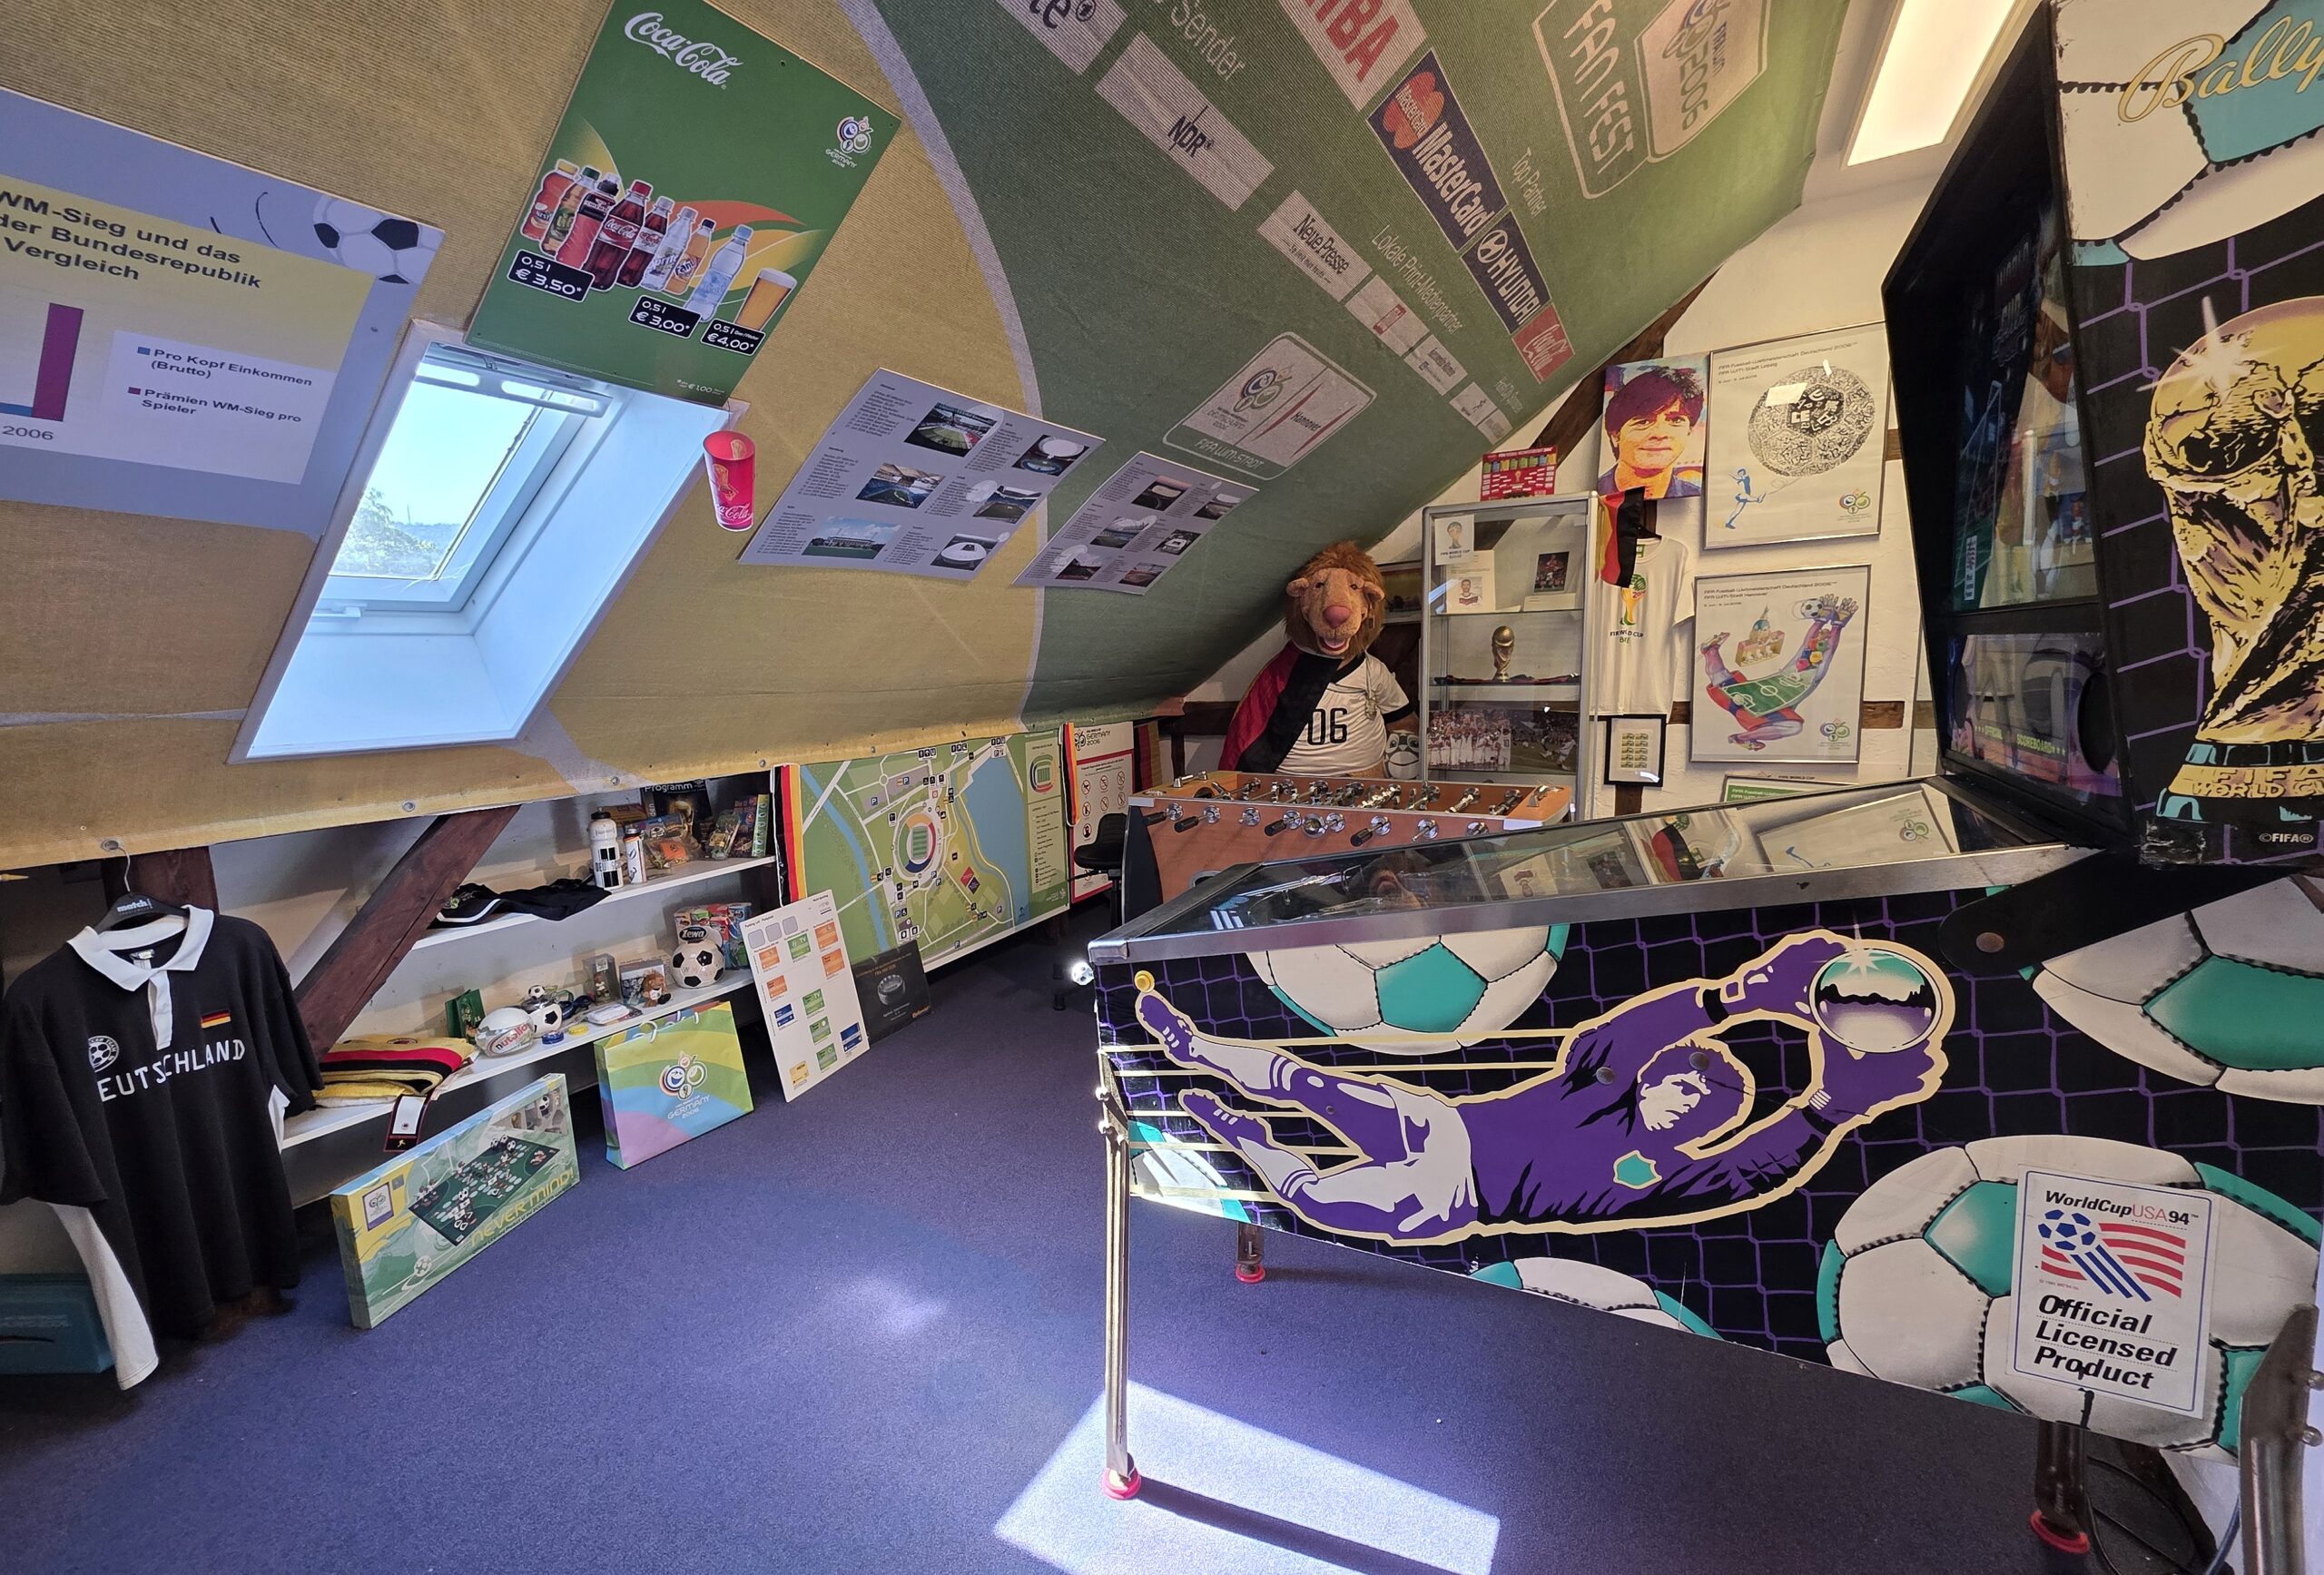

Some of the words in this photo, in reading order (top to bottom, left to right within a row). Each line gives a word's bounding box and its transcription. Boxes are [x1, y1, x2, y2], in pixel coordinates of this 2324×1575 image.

[624, 12, 743, 87] Coca-Cola
[1170, 4, 1246, 81] Sender
[1563, 0, 1620, 102] FAN
[1680, 41, 1709, 132] 2006
[2118, 15, 2324, 123] Bally
[1394, 85, 1429, 137] MasterCard
[1583, 80, 1635, 175] FEST
[1167, 105, 1208, 158] NDR
[1413, 120, 1495, 238] MasterCard
[1511, 146, 1533, 183] Top
[1522, 170, 1547, 219] Partner
[0, 191, 126, 238] WM-Sieg
[137, 230, 189, 251] und
[197, 244, 241, 263] das
[605, 219, 635, 240] Coca-Cola
[1293, 213, 1325, 254] Neue
[1317, 235, 1351, 275] Presse
[0, 213, 42, 234] der
[52, 226, 262, 289] Bundesrepublik
[4, 237, 139, 281] Vergleich
[521, 256, 545, 270] 0,5
[515, 268, 529, 281] €
[1372, 224, 1408, 268] Lokale
[1398, 256, 1463, 335] Print-Medienpartner
[1486, 249, 1541, 325] HYUNDAI
[635, 311, 649, 321] €
[642, 300, 662, 312] 0,5
[707, 332, 720, 342] €
[714, 322, 731, 333] 0,5
[151, 359, 212, 379] (Brutto)
[153, 349, 182, 361] Pro
[187, 355, 226, 369] Kopf
[227, 363, 313, 386] Einkommen
[142, 399, 198, 416] Spieler
[144, 389, 209, 407] Prämien
[212, 400, 275, 419] WM-Sieg
[278, 413, 302, 423] pro
[1290, 411, 1322, 432] Hannover
[2, 424, 54, 441] 2006
[1194, 438, 1218, 452] FIFA
[1086, 730, 1111, 741] GERMANY
[1308, 707, 1348, 747] 06
[2191, 782, 2286, 798] WORLD
[2213, 767, 2324, 783] FIFA
[116, 900, 148, 912] match
[681, 929, 706, 939] Zewa
[495, 1022, 529, 1050] nutella
[97, 1039, 246, 1102] EUTSCHLAND
[667, 1094, 711, 1119] GERMANY
[682, 1107, 700, 1118] 2006
[470, 1200, 527, 1248] NEVER
[529, 1166, 575, 1207] MIND!
[2038, 1294, 2152, 1334] Official
[2034, 1320, 2178, 1367] Licensed
[2034, 1345, 2155, 1390] Product
